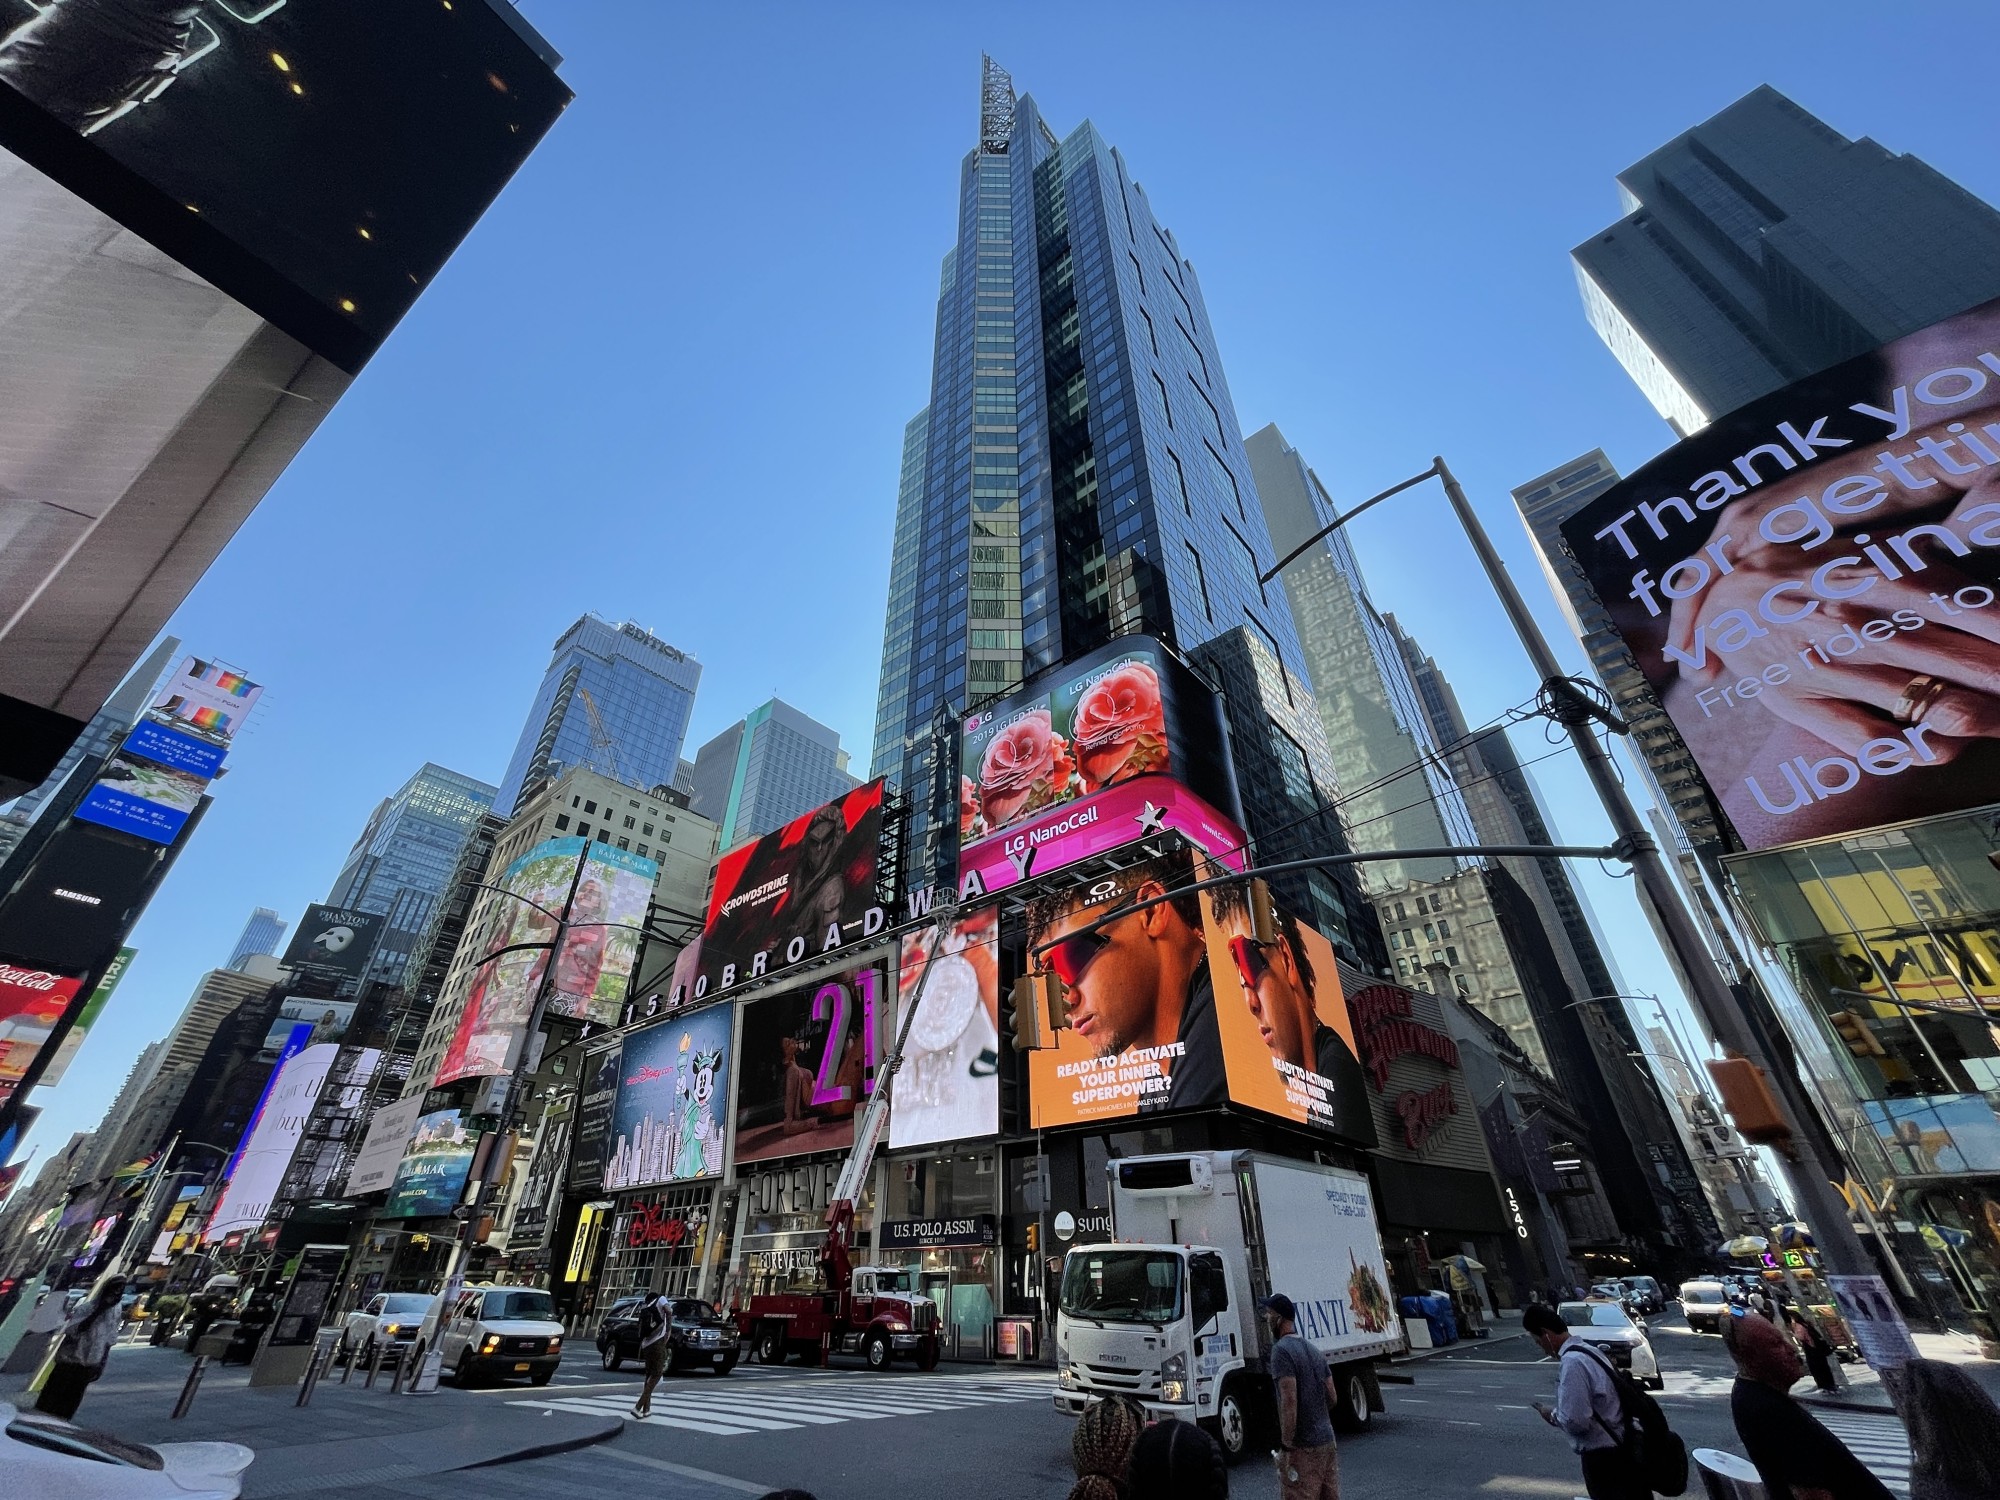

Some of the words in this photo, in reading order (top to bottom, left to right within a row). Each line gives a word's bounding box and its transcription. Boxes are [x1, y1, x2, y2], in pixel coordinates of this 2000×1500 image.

[1593, 415, 1854, 561] Thank
[1628, 532, 1739, 618] for
[623, 622, 685, 664] EDITION
[1695, 662, 1792, 718] Free
[1798, 608, 1926, 671] rides
[1928, 585, 1995, 616] to
[1069, 682, 1084, 696] LG
[1085, 658, 1132, 689] NanoCell
[221, 699, 240, 710] PGIM
[979, 711, 993, 726] LG
[972, 727, 995, 745] 2019
[995, 721, 1007, 733] LG
[1008, 712, 1025, 727] LED
[1026, 704, 1039, 717] TV
[1085, 737, 1109, 752] Refined
[1108, 729, 1125, 743] Color
[1126, 723, 1146, 736] Purity
[1744, 721, 1938, 816] Uber
[1005, 836, 1025, 857] LG
[1029, 805, 1099, 847] NanoCell
[1201, 821, 1235, 850] www.LG.com
[598, 848, 622, 863] BAHA
[630, 859, 649, 873] MAR
[54, 888, 102, 905] SAMSUNG
[723, 873, 790, 912] CROWDSTRIKE
[1084, 887, 1126, 906] OAKLEY
[319, 910, 370, 926] PHANTOM
[1351, 984, 1414, 1048] PLANET
[811, 967, 883, 1106] 21
[1057, 1059, 1100, 1078] READY
[1099, 1054, 1118, 1070] TO
[1120, 1041, 1186, 1066] ACTIVATE
[1366, 1020, 1458, 1094] HOLLYWOOD
[1079, 1070, 1117, 1088] YOUR
[1118, 1062, 1161, 1082] INNER
[1272, 1055, 1295, 1076] READY
[1294, 1065, 1306, 1081] TO
[1305, 1070, 1335, 1092] ACTIVATE
[1286, 1075, 1307, 1094] YOUR
[1306, 1082, 1328, 1102] INNER
[1072, 1075, 1173, 1105] SUPERPOWER?
[1134, 1098, 1154, 1108] OAKLEY
[1154, 1095, 1169, 1105] KATO
[1285, 1088, 1334, 1117] SUPERPOWER?
[421, 1163, 447, 1177] MAR
[853, 1177, 864, 1201] NORTH
[861, 1153, 872, 1177] SHORE
[869, 1131, 878, 1152] NEON
[748, 1163, 833, 1216] FOREVE
[457, 1208, 472, 1216] ONE
[1505, 1187, 1528, 1239] 1540
[628, 1201, 686, 1258] Disney
[893, 1224, 911, 1238] U.S.
[912, 1221, 942, 1237] POLO
[943, 1219, 977, 1236] ASSN.
[919, 1237, 934, 1245] SINCE
[760, 1250, 801, 1270] FOREVER
[1098, 1353, 1127, 1364] ISUZU
